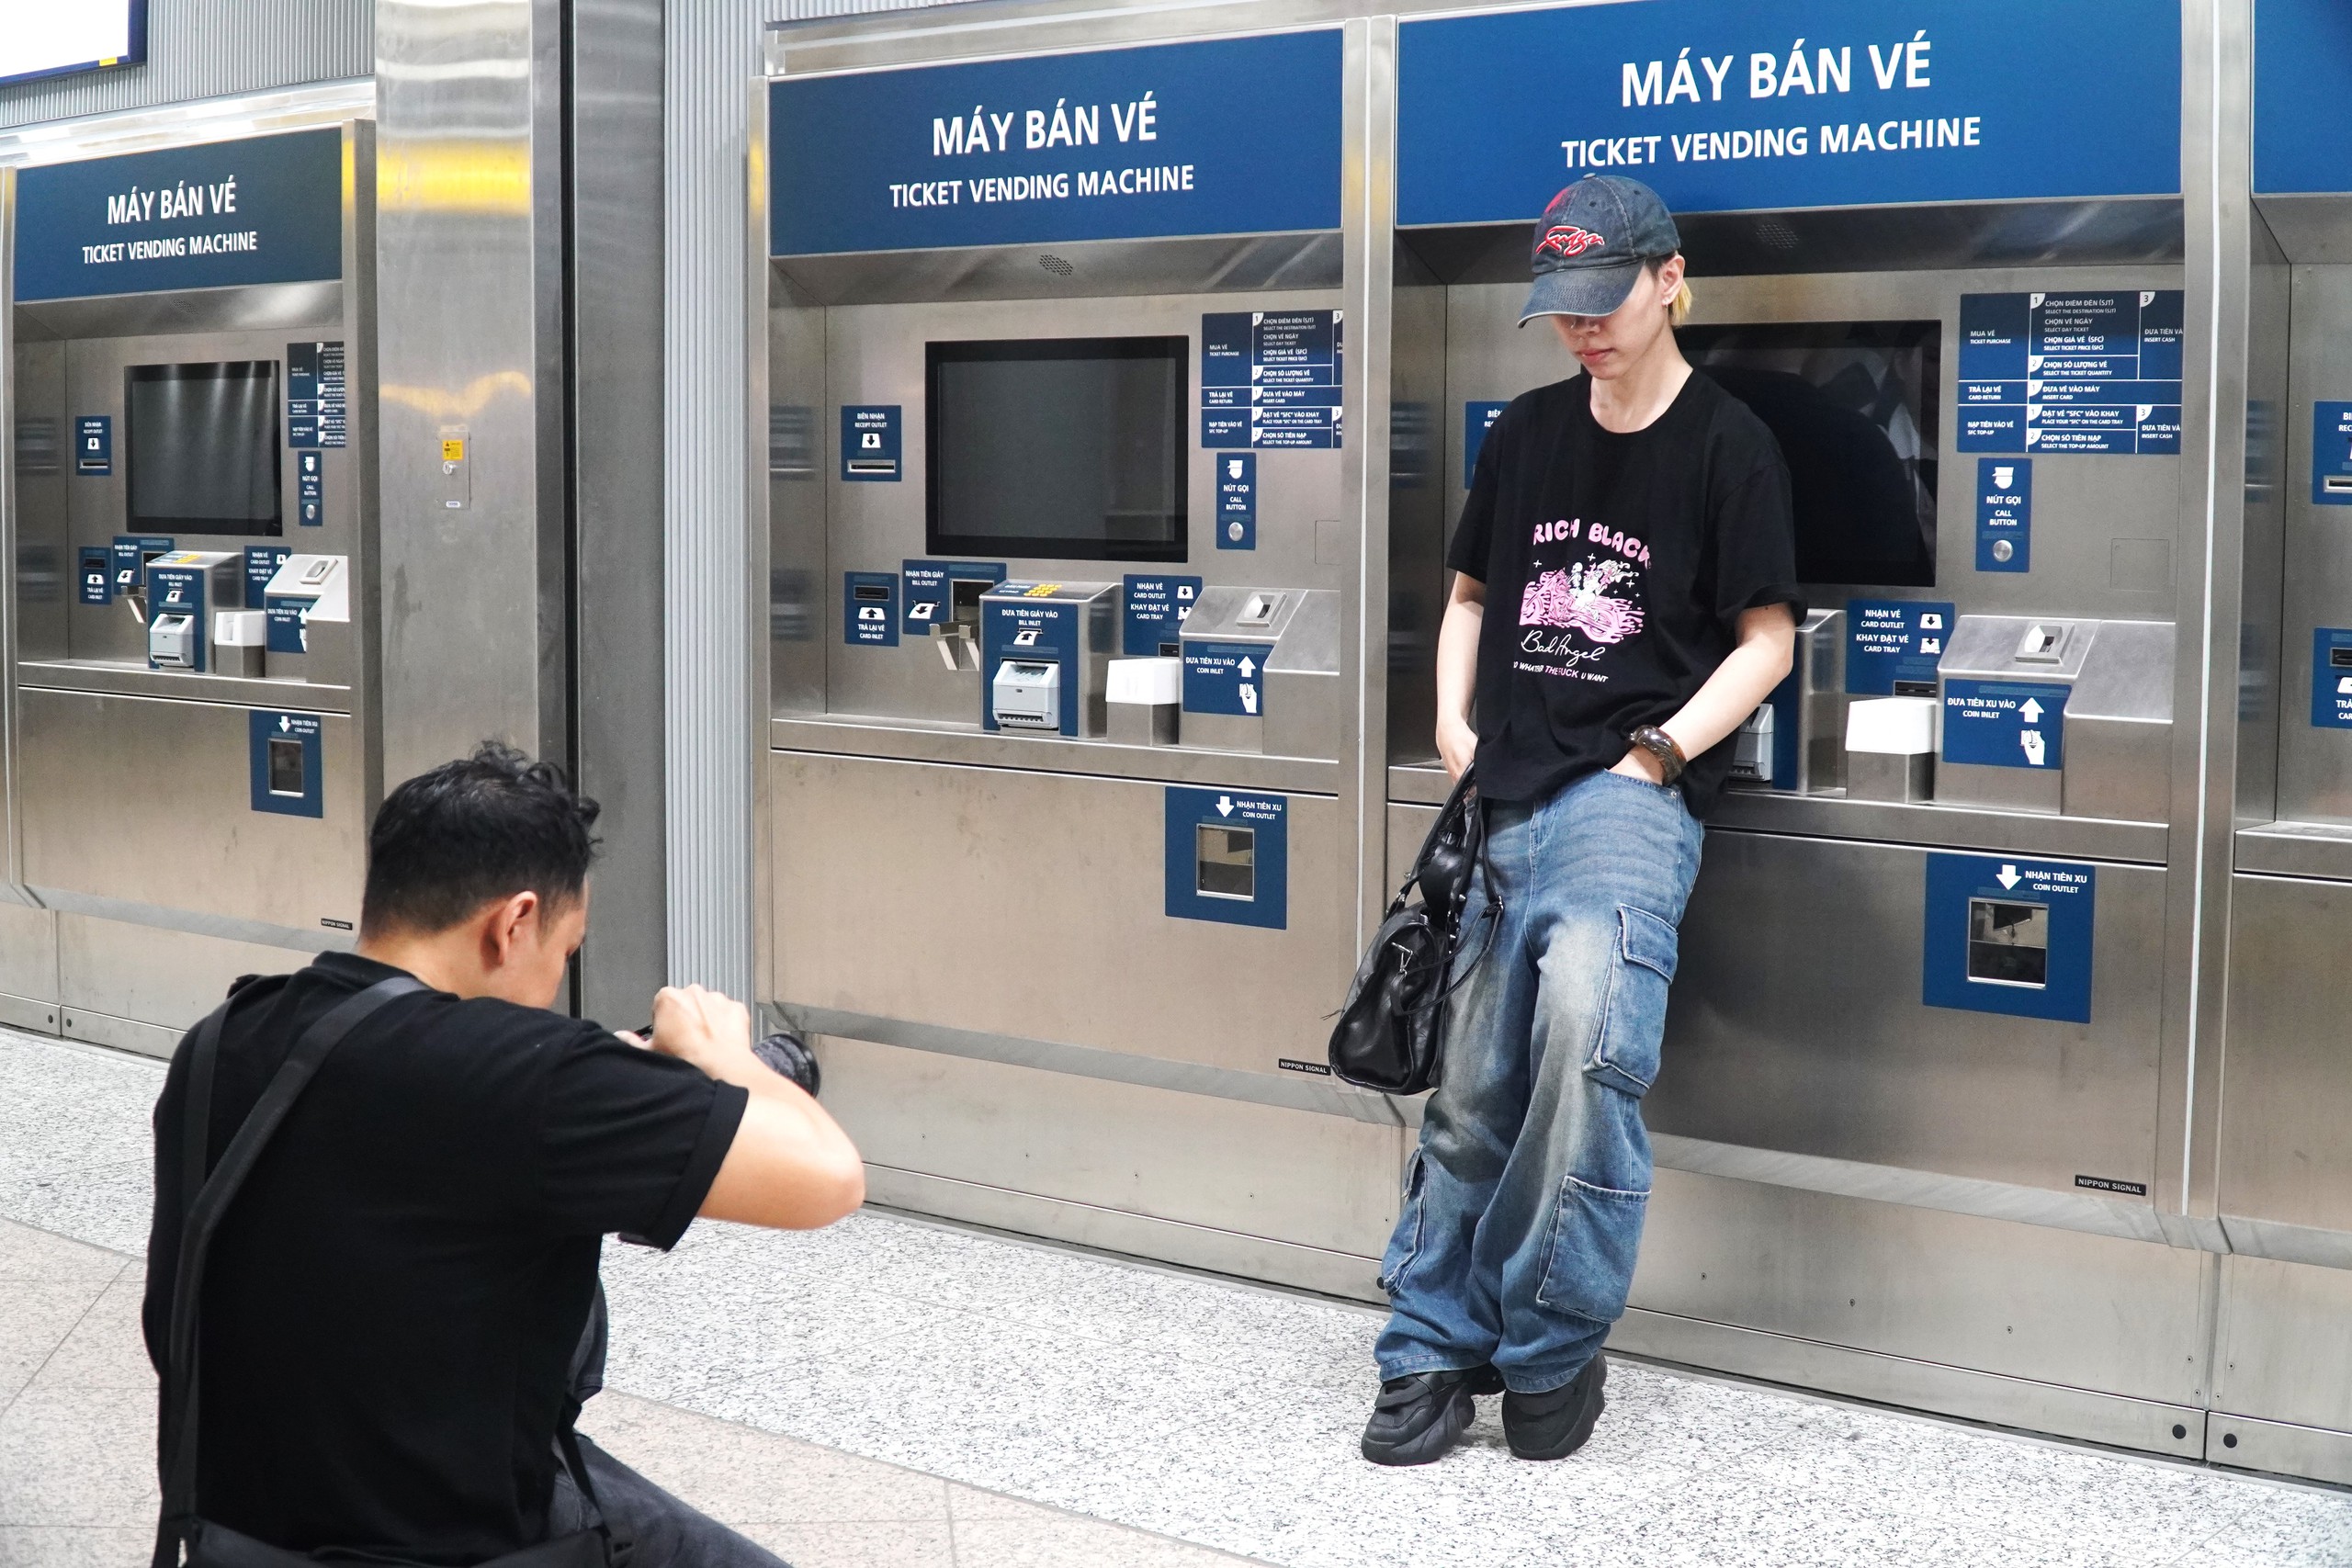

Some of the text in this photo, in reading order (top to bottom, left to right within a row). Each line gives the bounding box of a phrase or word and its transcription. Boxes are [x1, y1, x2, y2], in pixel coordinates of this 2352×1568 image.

[1623, 30, 1931, 107] MÁY BÁN VÉ
[933, 90, 1157, 156] MÁY BÁN VÉ
[1561, 116, 1981, 168] TICKET VENDING MACHINE
[889, 164, 1194, 208] TICKET VENDING MACHINE
[107, 174, 236, 224] MÁY BÁN VÉ
[82, 231, 257, 264] TICKET VENDING MACHINE
[2143, 295, 2149, 303] 3
[2087, 335, 2104, 344] (SFC)
[1223, 483, 1250, 493] NÚT GỌI
[1986, 494, 2021, 506] NÚT GỌI
[1989, 518, 2018, 526] BUTTON
[1533, 518, 1580, 546] RICH
[1155, 581, 1163, 591] VÉ
[1161, 604, 1170, 612] VÉ
[1890, 608, 1901, 618] VÉ
[877, 624, 885, 632] VÉ
[1856, 634, 1879, 642] KHAY
[1898, 634, 1909, 643] VÉ
[1521, 630, 1606, 667] Bad Angel
[1222, 658, 1236, 666] VÀO
[1947, 698, 1965, 706] ĐƯA
[1985, 699, 1997, 708] XU
[1998, 699, 2017, 709] VÀO
[1256, 812, 1276, 820] OUTLET
[2074, 874, 2087, 884] XU
[2032, 883, 2079, 894] COIN OUTLET
[1280, 1061, 1328, 1074] NIPPON SIGNAL
[2078, 1178, 2142, 1193] NIPPON SIGNAL
